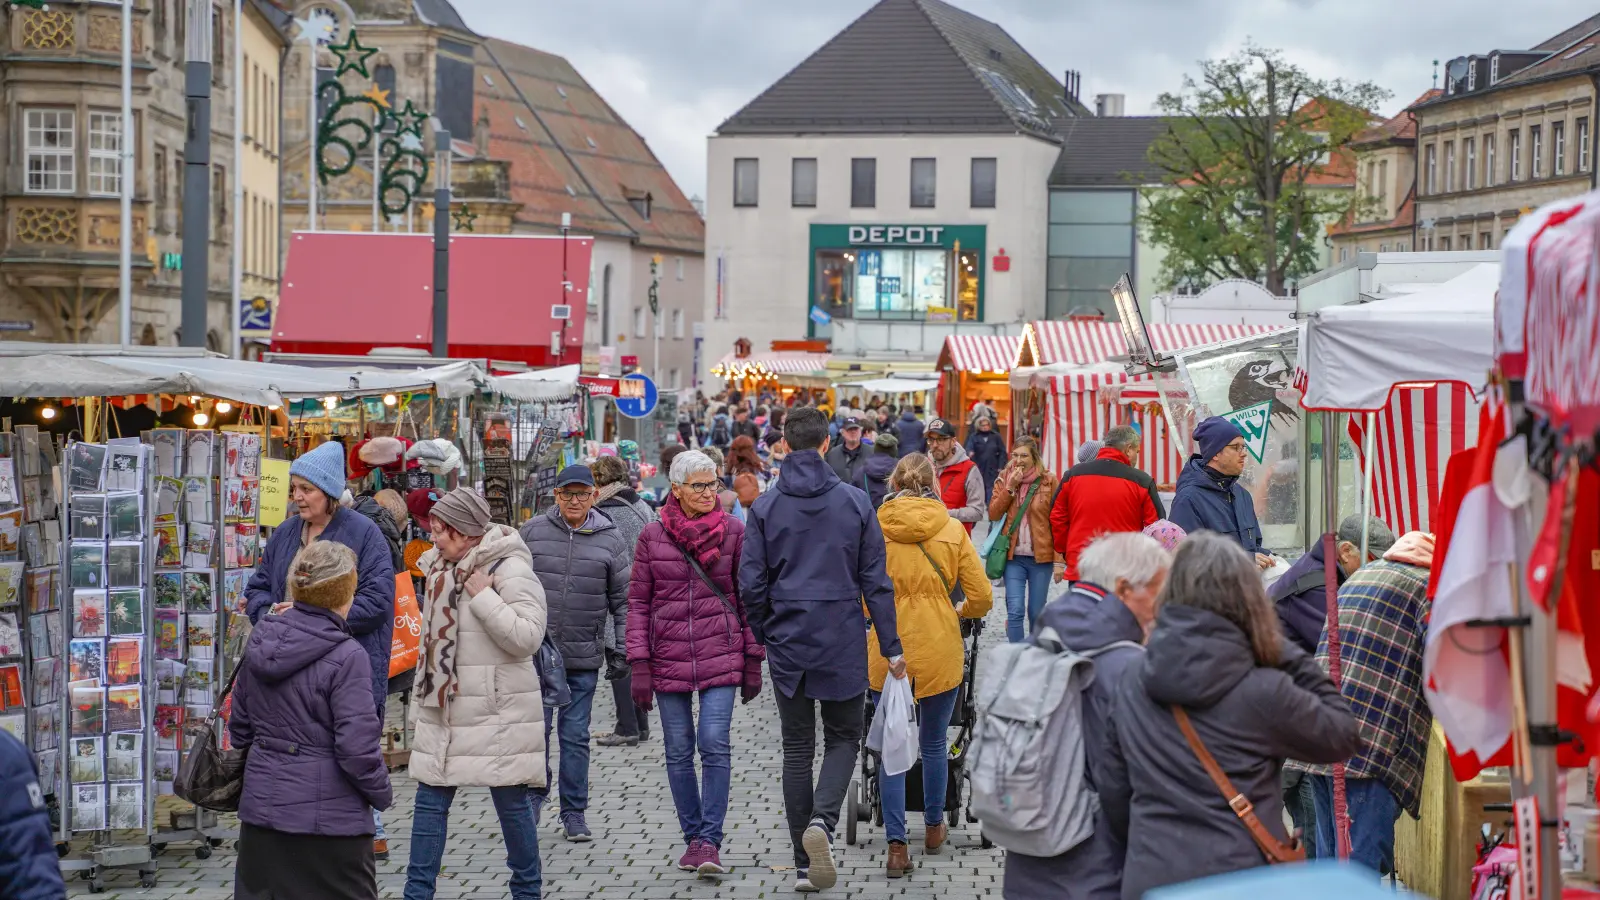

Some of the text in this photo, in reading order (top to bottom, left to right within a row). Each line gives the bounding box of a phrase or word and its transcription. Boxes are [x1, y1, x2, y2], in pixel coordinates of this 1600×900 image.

[849, 226, 944, 243] DEPOT
[1236, 410, 1258, 421] WILD
[260, 473, 278, 482] arten
